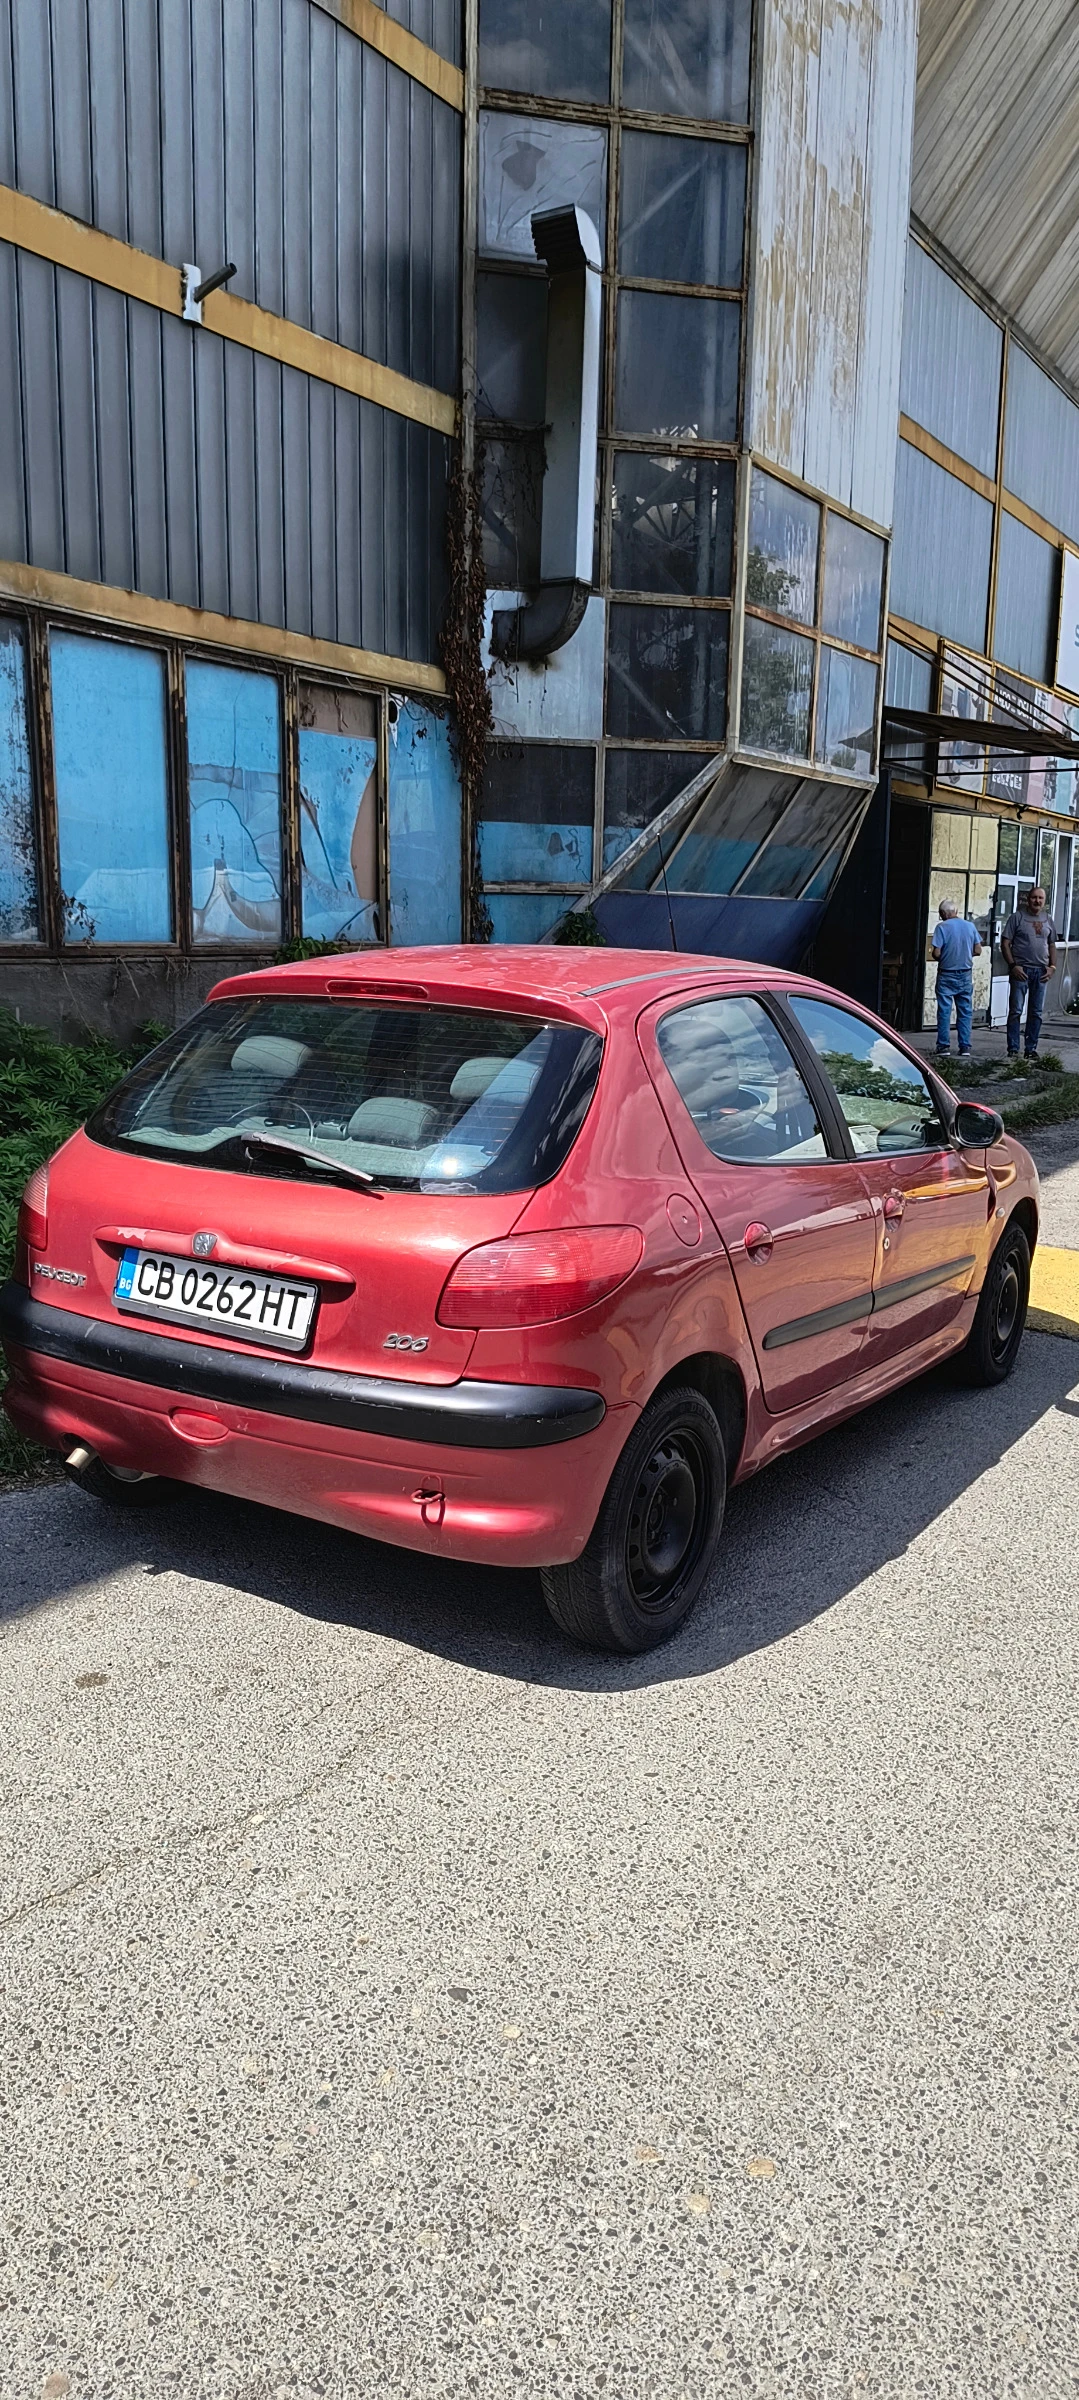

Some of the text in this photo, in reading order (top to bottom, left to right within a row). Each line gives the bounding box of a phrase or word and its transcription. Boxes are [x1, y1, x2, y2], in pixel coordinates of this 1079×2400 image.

[34, 1261, 87, 1288] PEUGEOT
[118, 1277, 132, 1291] BG
[137, 1258, 308, 1329] CB 0262 HT
[383, 1333, 429, 1351] 206
